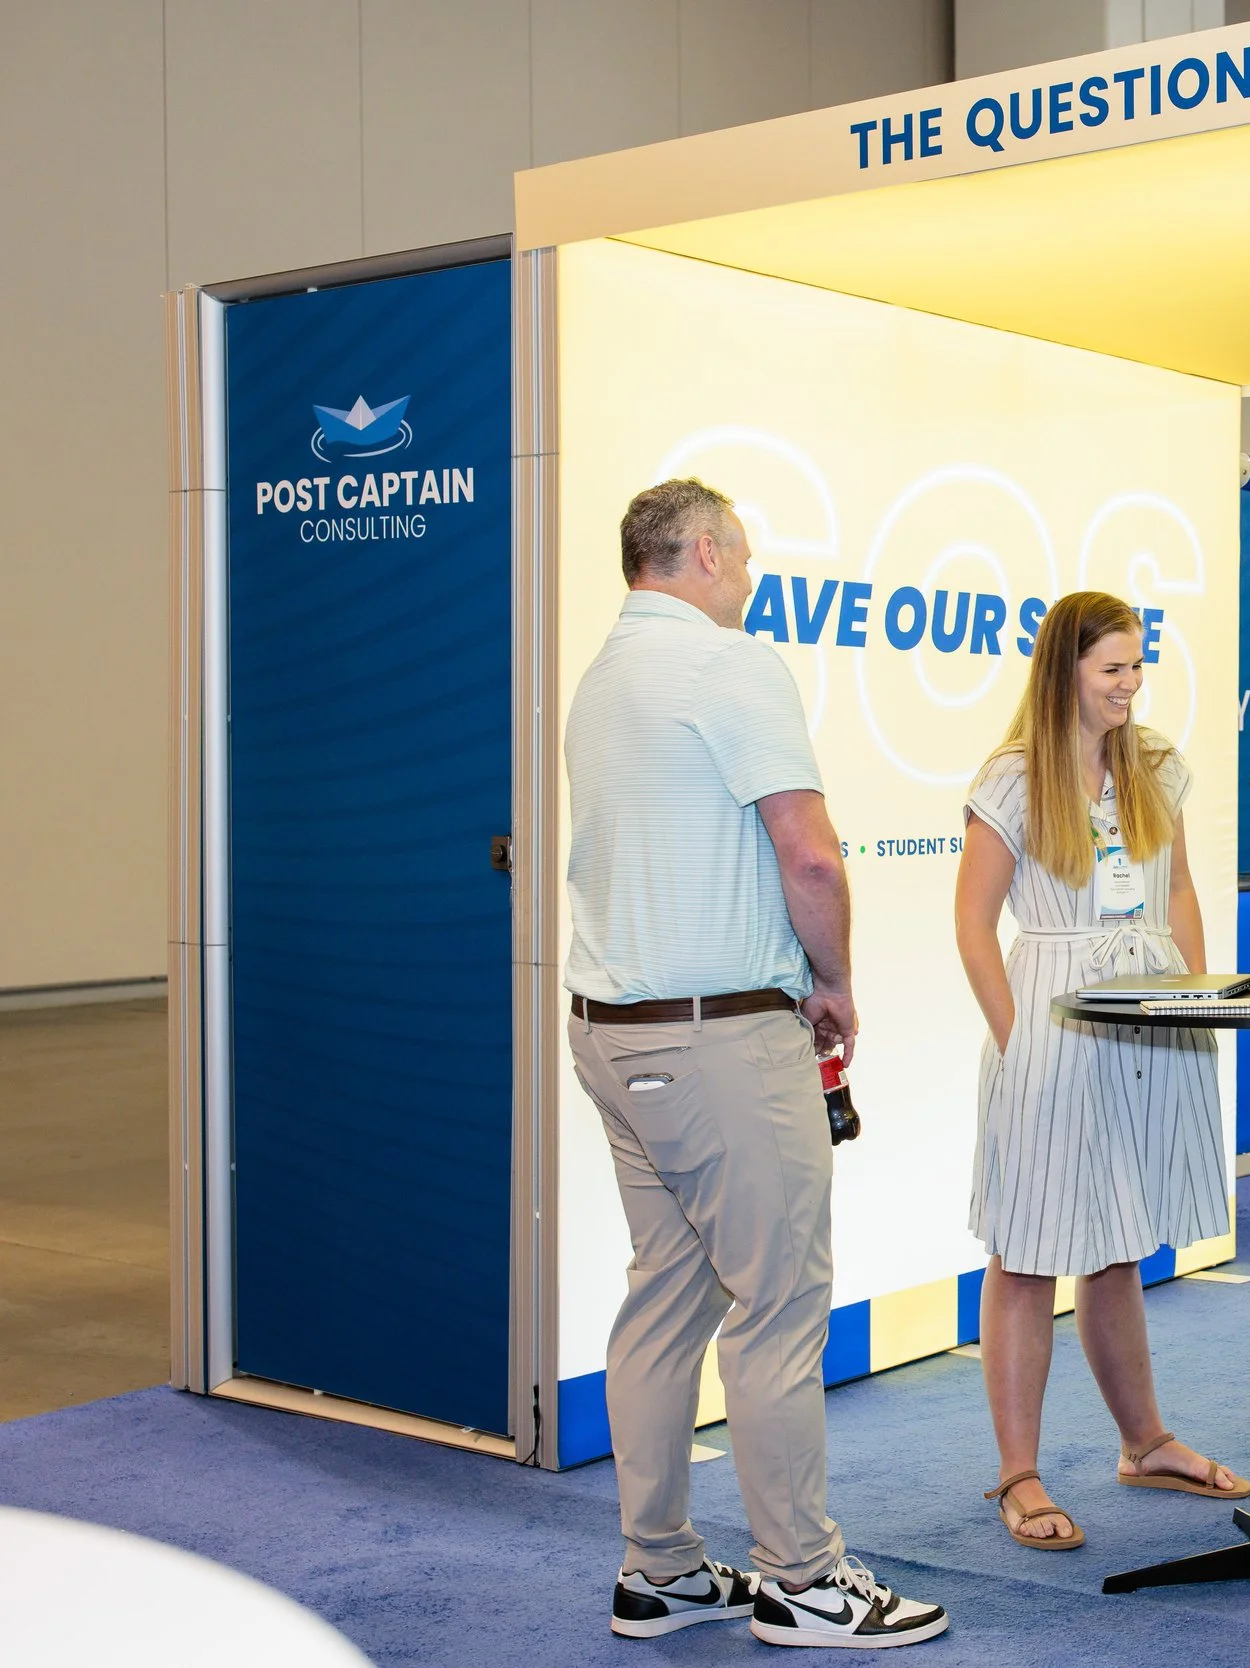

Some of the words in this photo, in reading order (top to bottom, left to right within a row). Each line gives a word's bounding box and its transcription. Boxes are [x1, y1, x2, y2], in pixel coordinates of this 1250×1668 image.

[850, 107, 943, 169] THE
[256, 476, 330, 515] POST
[336, 467, 475, 509] CAPTAIN
[300, 514, 426, 543] CONSULTING
[744, 573, 873, 648] AVE
[885, 586, 1007, 656] OUR
[876, 837, 946, 857] STUDENT
